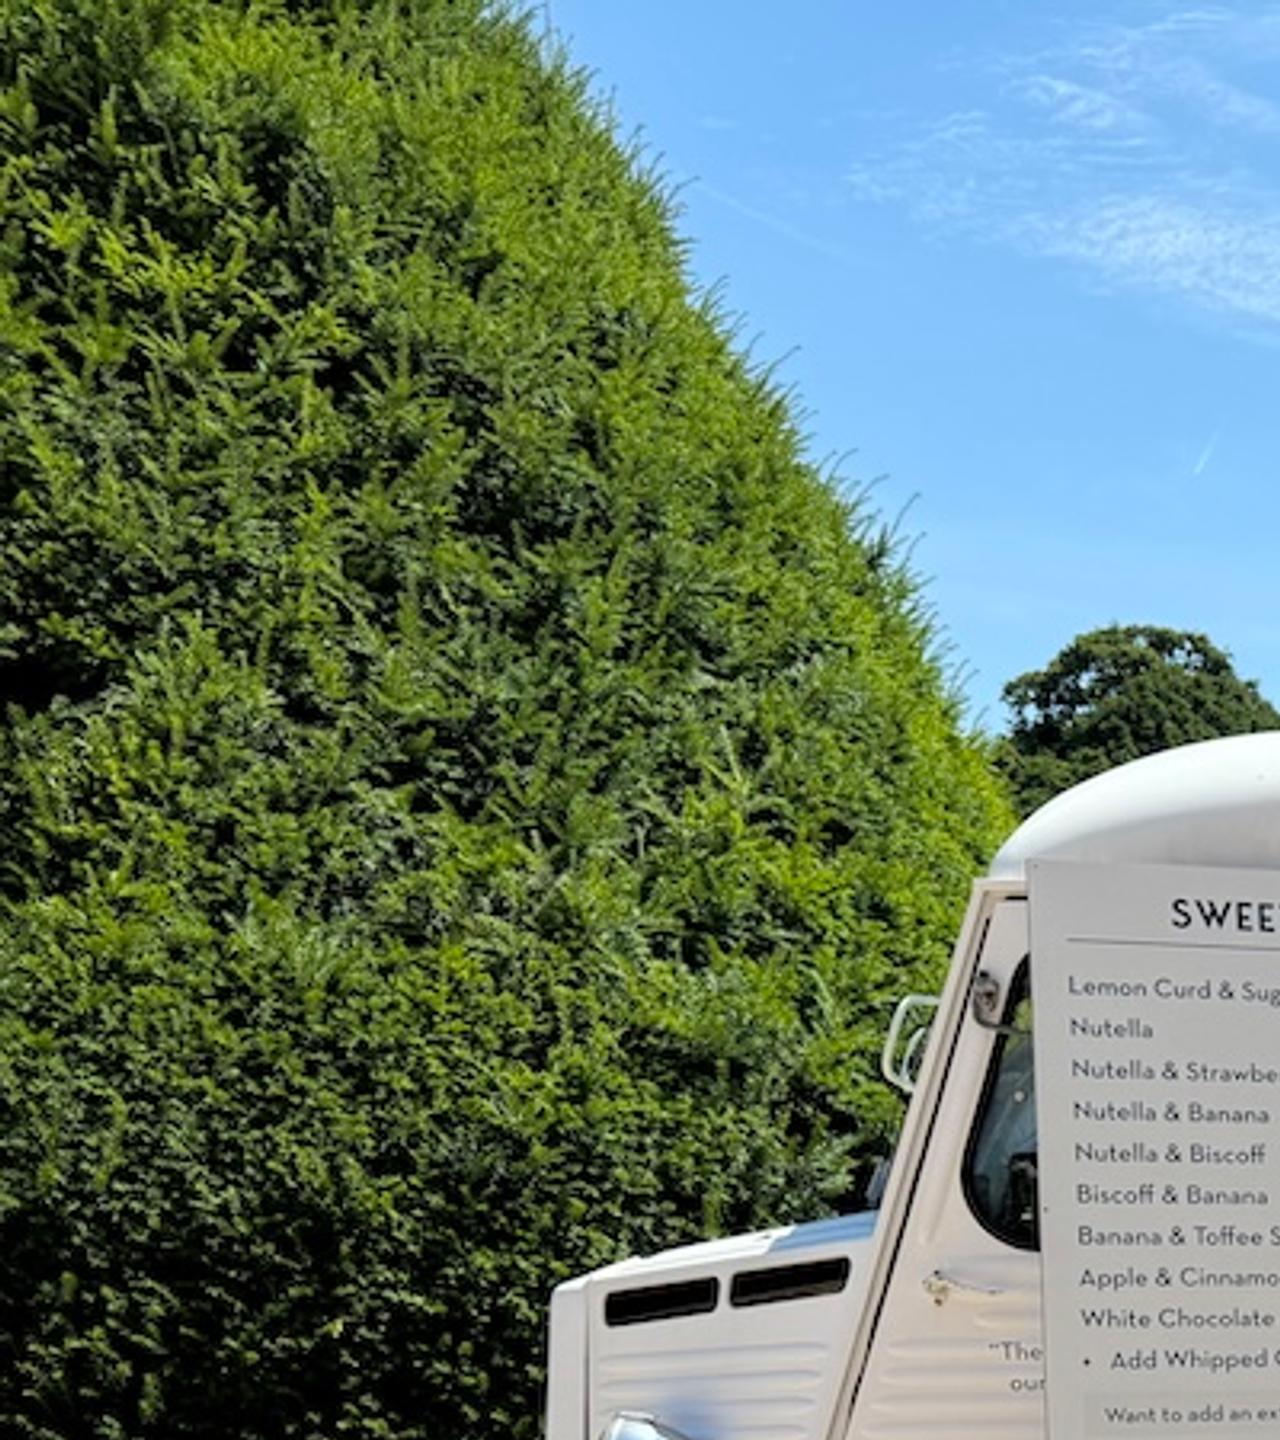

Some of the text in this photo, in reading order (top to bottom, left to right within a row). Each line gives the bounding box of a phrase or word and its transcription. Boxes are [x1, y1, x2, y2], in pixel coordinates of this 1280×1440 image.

[1069, 975, 1147, 996] Lemon
[1153, 978, 1211, 999] Curd
[1219, 982, 1233, 999] &
[1071, 1018, 1153, 1038] Nutella
[1072, 1059, 1155, 1079] Nutella
[1162, 1063, 1178, 1079] &
[1074, 1102, 1270, 1124] Nutella & Banana
[1075, 1143, 1265, 1164] Nutella & Biscoff
[1077, 1183, 1268, 1204] Biscoff & Banana
[1078, 1225, 1162, 1245] Banana
[1169, 1228, 1185, 1245] &
[1194, 1226, 1262, 1246] Toffee
[1080, 1267, 1147, 1291] Apple
[1155, 1269, 1171, 1287] &
[1081, 1309, 1150, 1328] White
[1158, 1308, 1275, 1328] Chocolate
[1111, 1350, 1157, 1370] Add
[1164, 1348, 1268, 1373] Whipped
[1104, 1407, 1155, 1424] Want
[1161, 1406, 1182, 1423] to
[1187, 1404, 1225, 1423] add
[1230, 1408, 1252, 1423] an
